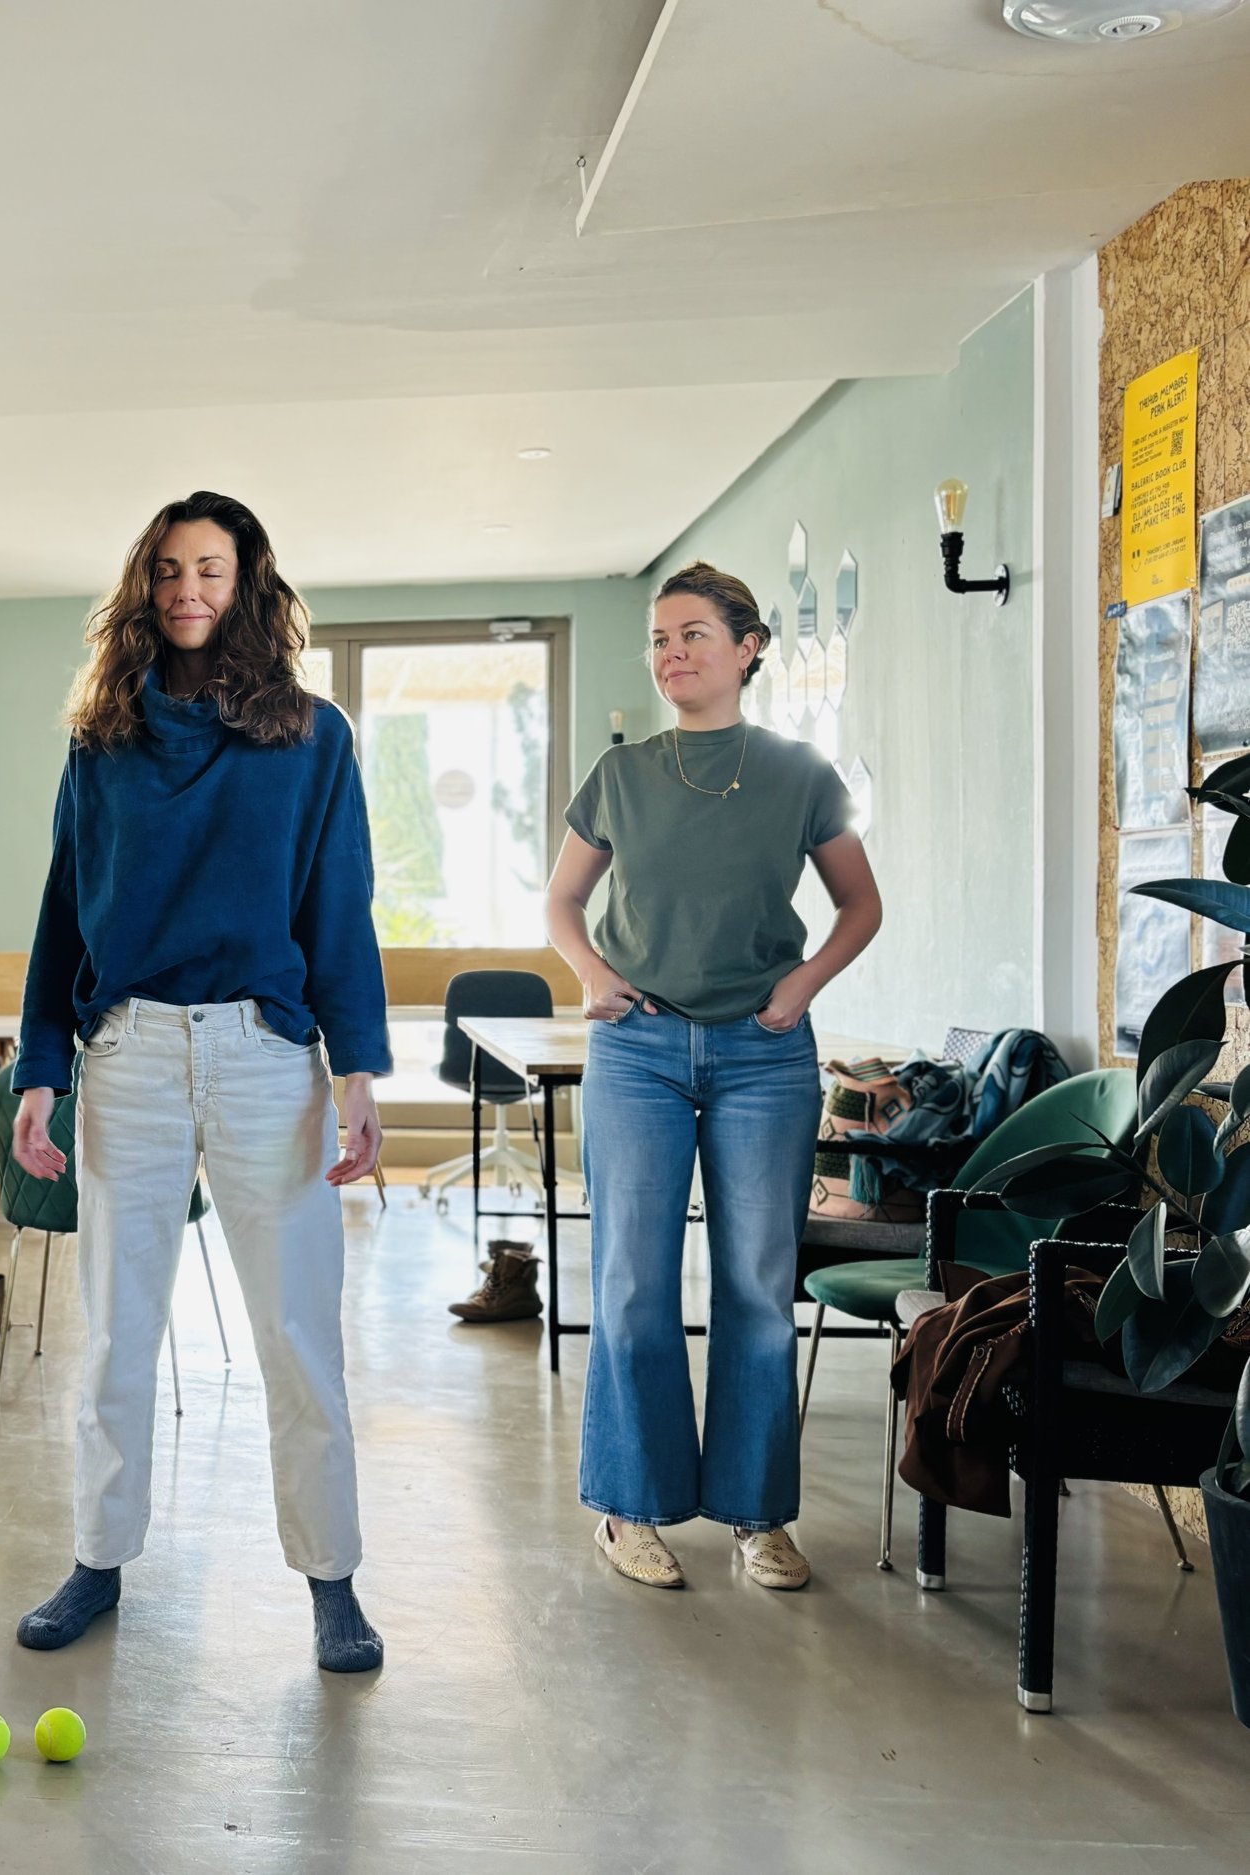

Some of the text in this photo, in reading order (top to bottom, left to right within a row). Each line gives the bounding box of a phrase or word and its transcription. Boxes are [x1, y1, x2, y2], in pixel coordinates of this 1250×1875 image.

[1160, 372, 1188, 400] MEMBERS
[1151, 387, 1187, 419] PERK ALERT!
[1132, 459, 1186, 491] BALEARIC BOOK CLUB
[1154, 498, 1170, 512] CLOSE
[1172, 492, 1183, 504] THE
[1144, 514, 1159, 530] MAKE
[1161, 510, 1170, 521] THE
